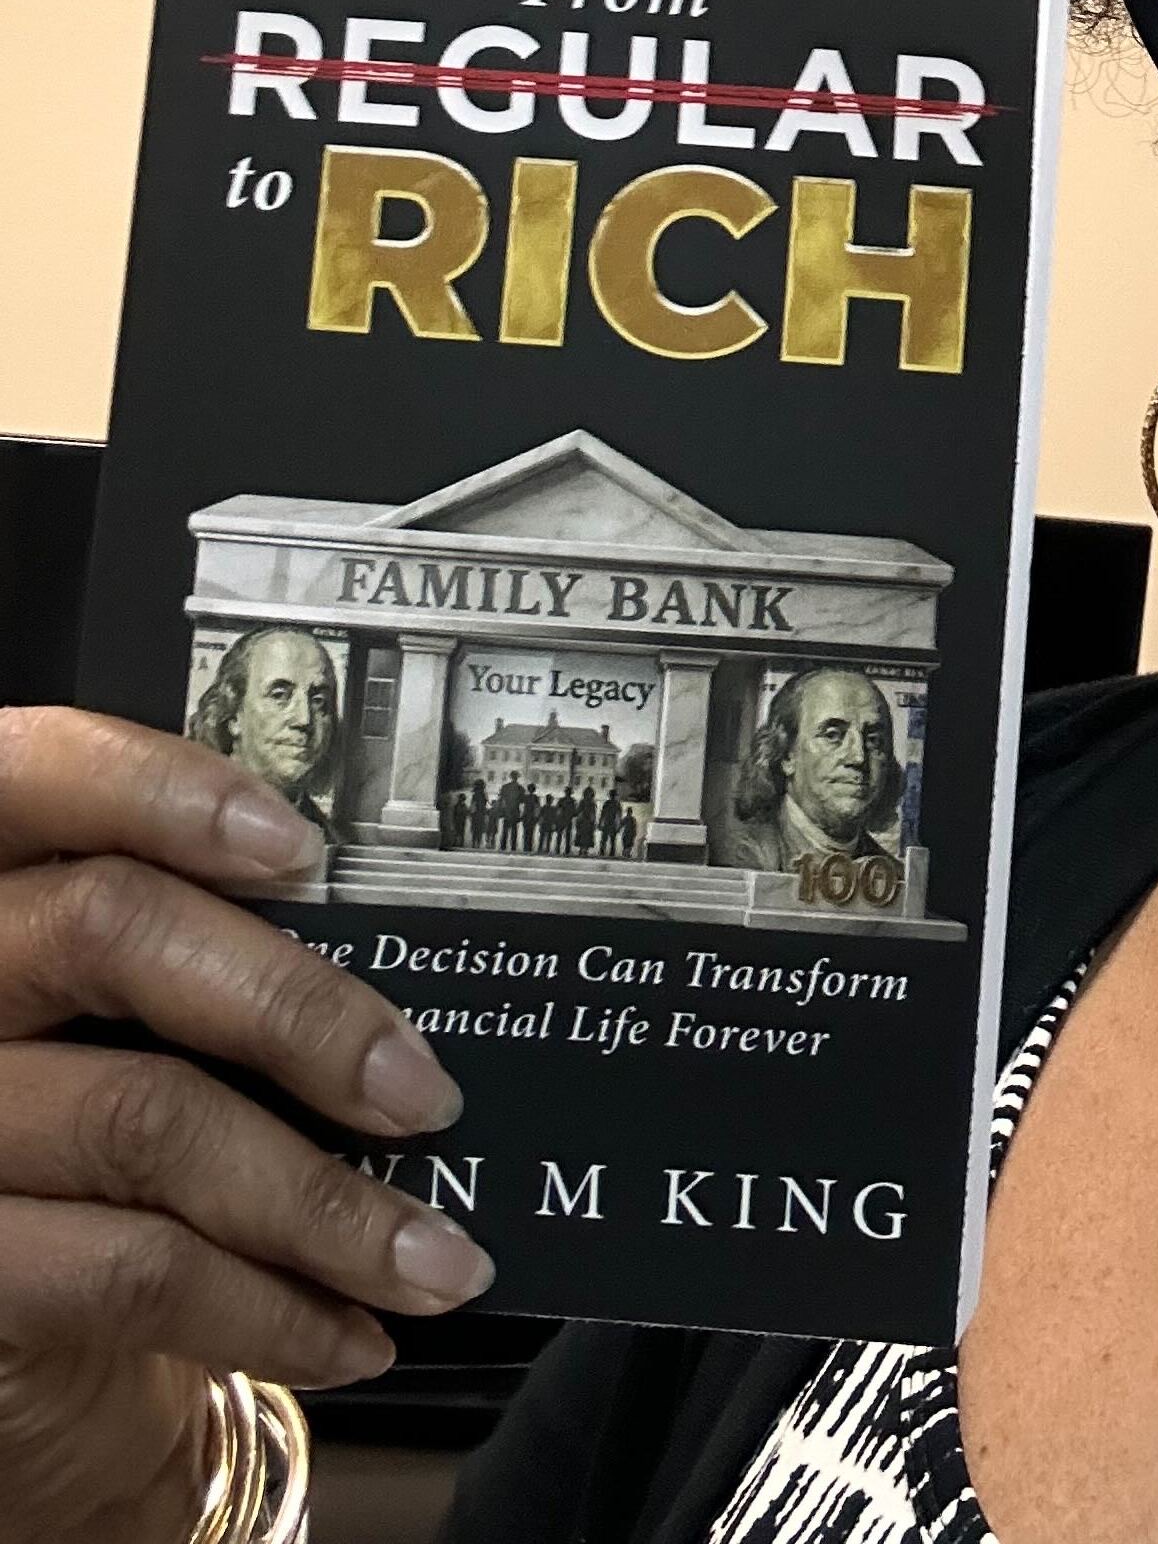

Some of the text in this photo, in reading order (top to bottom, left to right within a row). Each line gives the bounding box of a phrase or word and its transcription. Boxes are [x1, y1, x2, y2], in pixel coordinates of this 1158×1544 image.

[226, 10, 986, 167] REGULAR
[226, 144, 974, 375] to RICH
[335, 557, 795, 632] FAMILY BANK
[467, 663, 656, 711] Your Legacy
[793, 853, 898, 906] 100
[369, 934, 558, 979] Decision
[577, 945, 665, 985] Can
[686, 951, 909, 1007] Transform
[400, 1001, 830, 1056] ancial Life Forever
[535, 1160, 607, 1220] M
[660, 1169, 908, 1240] KING
